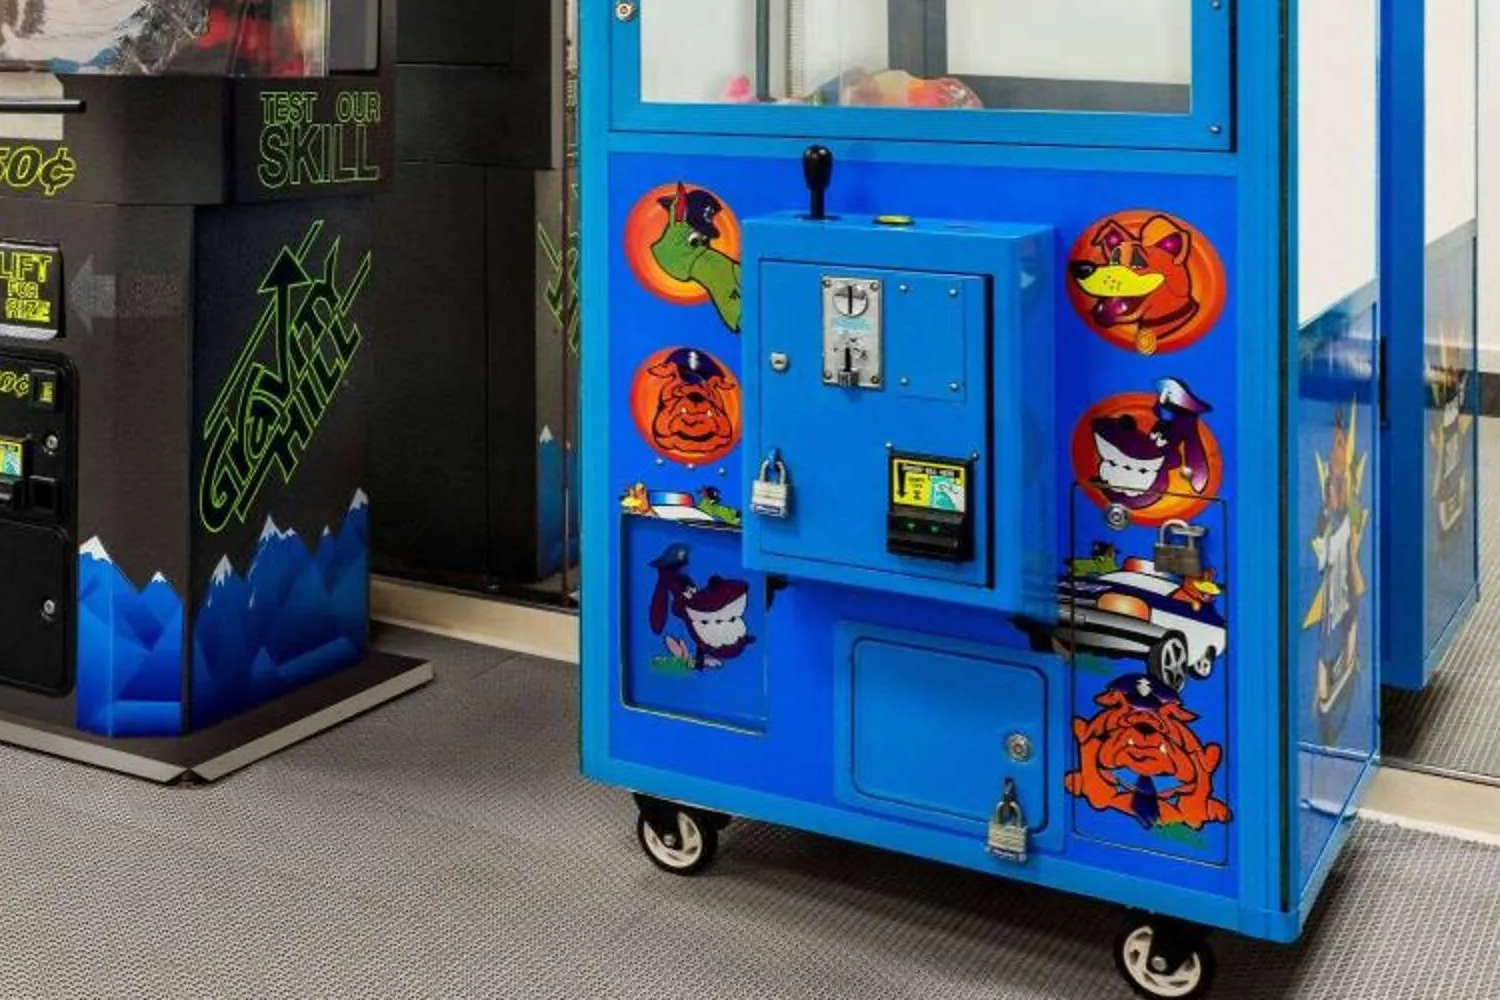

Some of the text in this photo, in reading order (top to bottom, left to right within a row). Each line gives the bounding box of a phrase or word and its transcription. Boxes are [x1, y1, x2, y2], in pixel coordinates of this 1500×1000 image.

[260, 90, 382, 125] TEST OUR
[257, 123, 381, 189] SKILL
[268, 312, 362, 484] HILL
